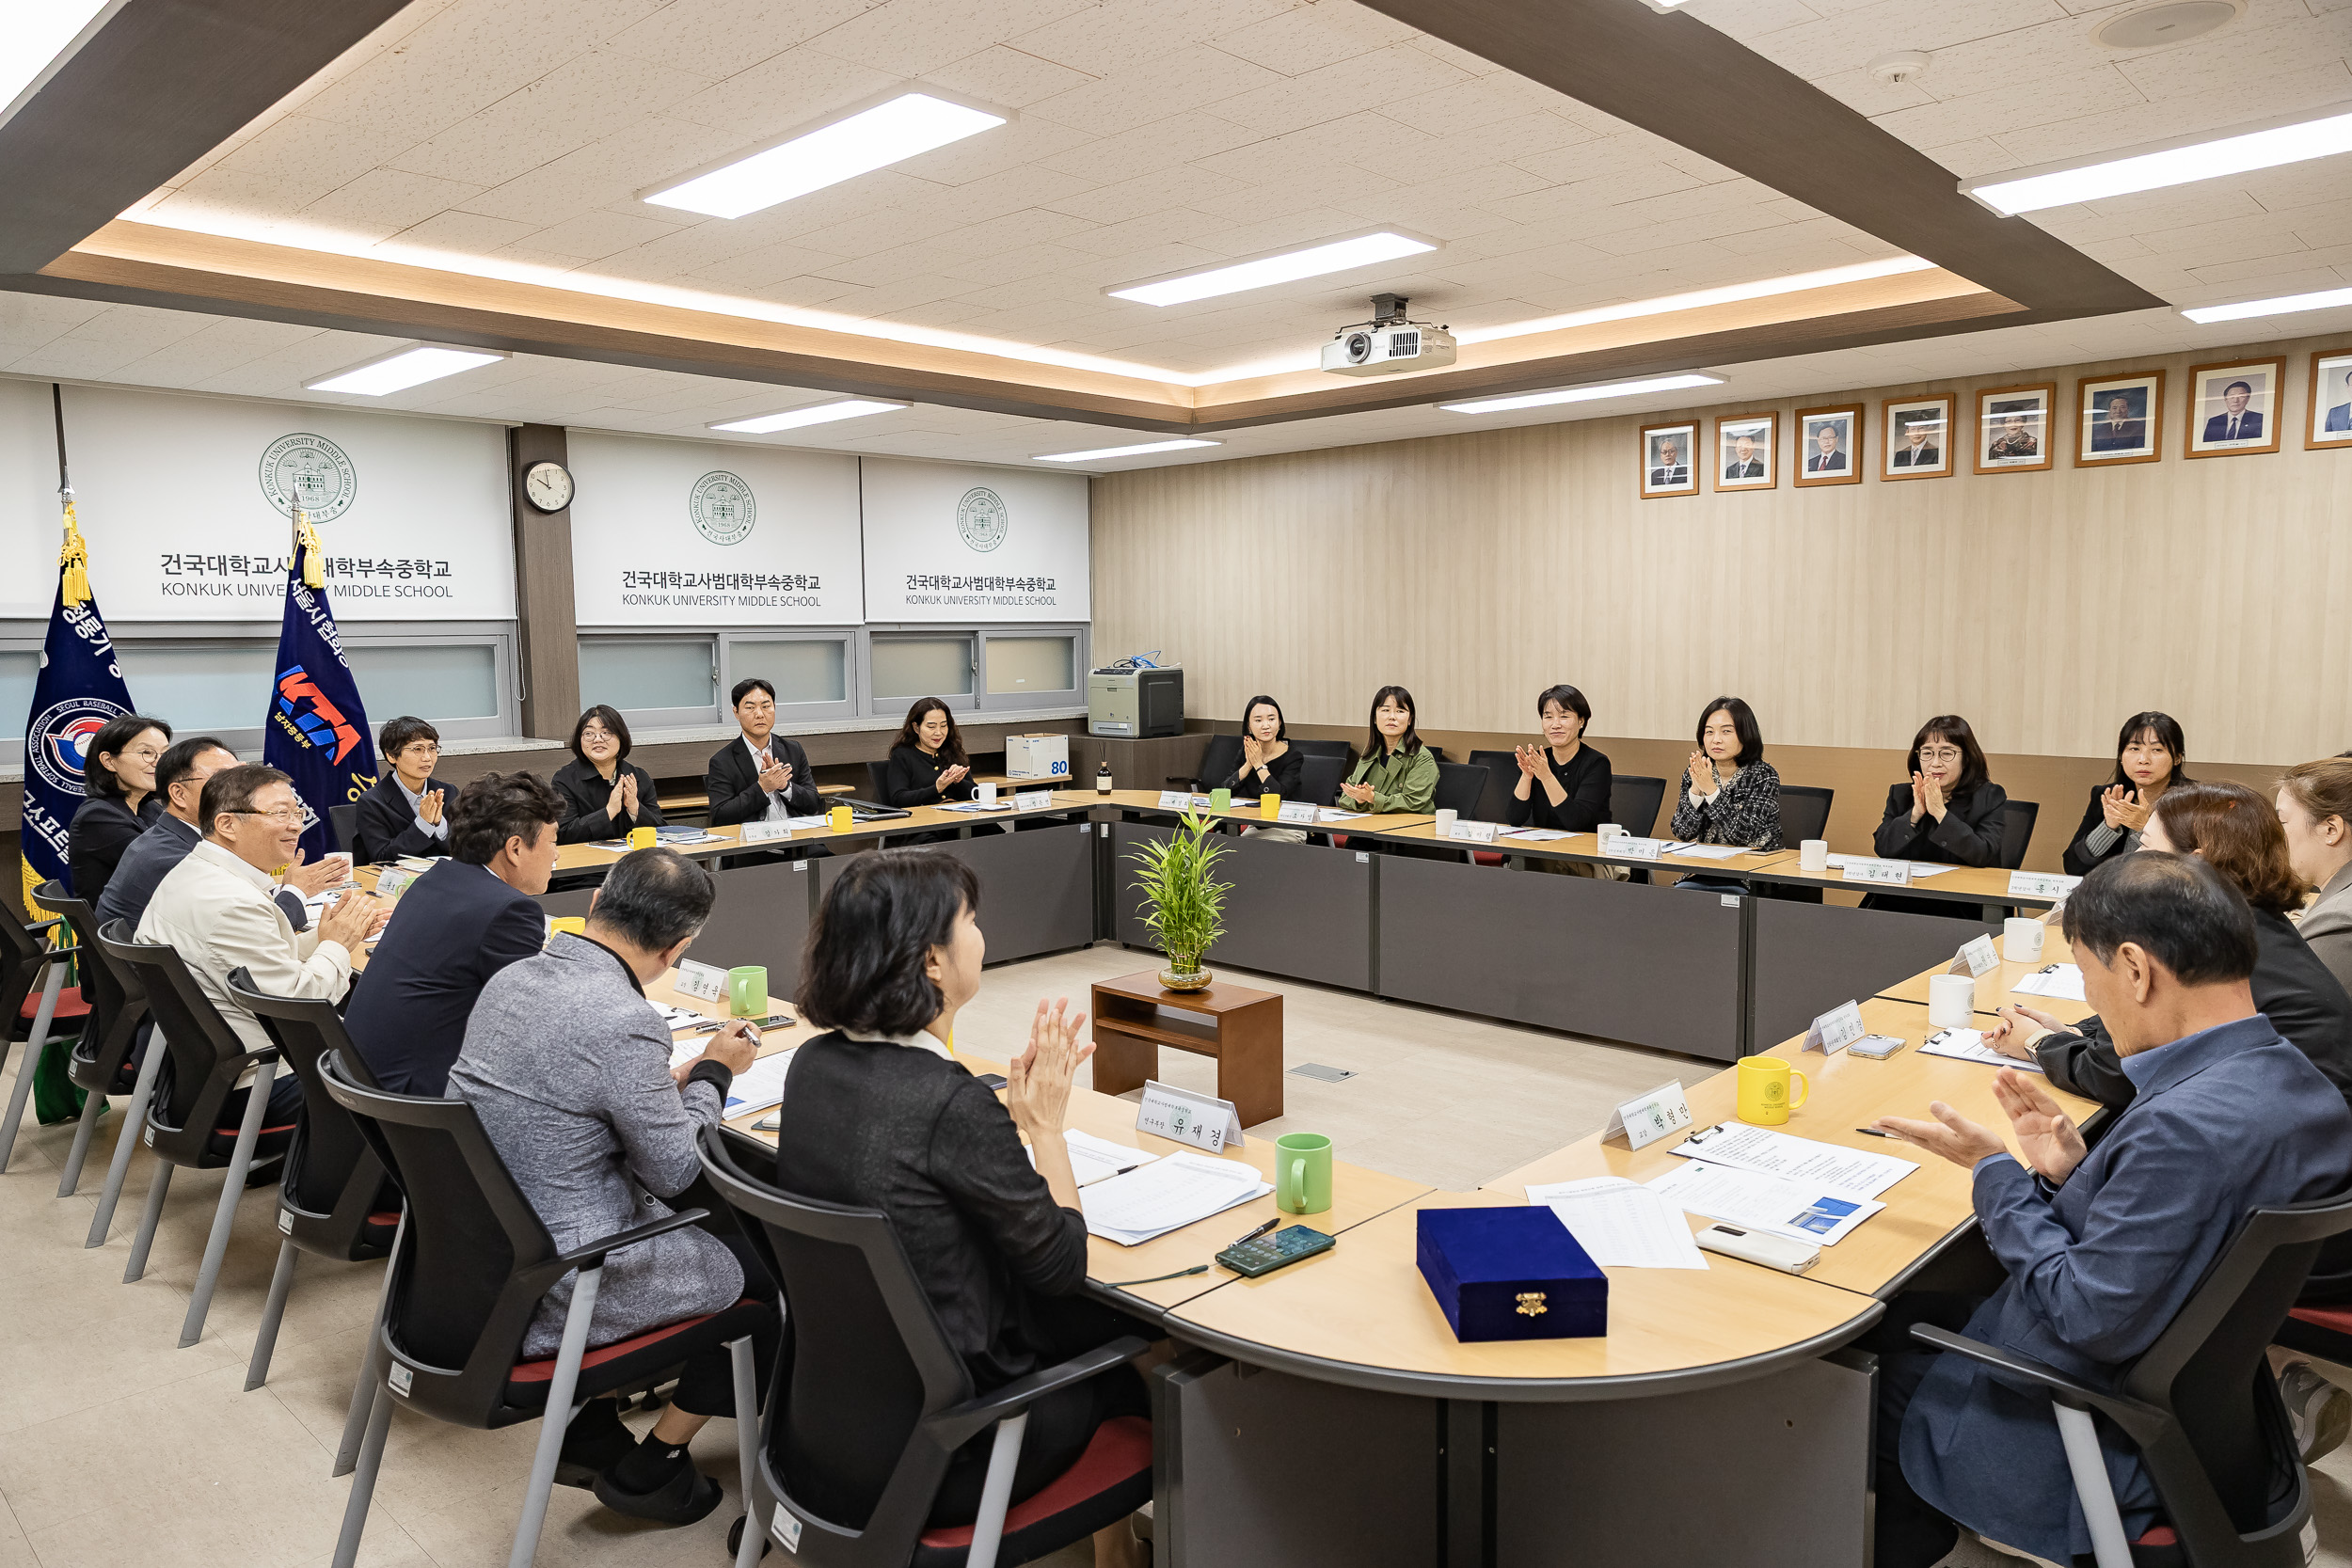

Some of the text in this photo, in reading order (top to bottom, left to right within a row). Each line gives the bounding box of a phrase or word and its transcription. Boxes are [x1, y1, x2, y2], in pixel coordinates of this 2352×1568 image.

[264, 437, 352, 499] KONKUK UNIVERSITY MIDDLE SCHOOL
[696, 474, 728, 494] UNIVERSITY
[160, 553, 453, 579] 건국대학교사대학부속중학교
[162, 582, 232, 596] KONKUK
[334, 584, 391, 597] MIDDLE
[395, 585, 453, 597] SCHOOL
[622, 571, 821, 592] 건국대학교사범대학부속중학교
[906, 575, 1057, 593] 건국대학교사범대학부속중학교
[623, 594, 820, 607] KONKUK UNIVERSITY MIDDLE SCHOOL
[906, 595, 1057, 606] KONKUK UNIVERSITY MIDDLE SCHOOL
[56, 701, 80, 713] SEOUL
[83, 701, 118, 715] BASEBALL
[275, 664, 361, 767] KTA
[31, 714, 53, 753] ASSOCIATION
[1051, 760, 1068, 774] 80
